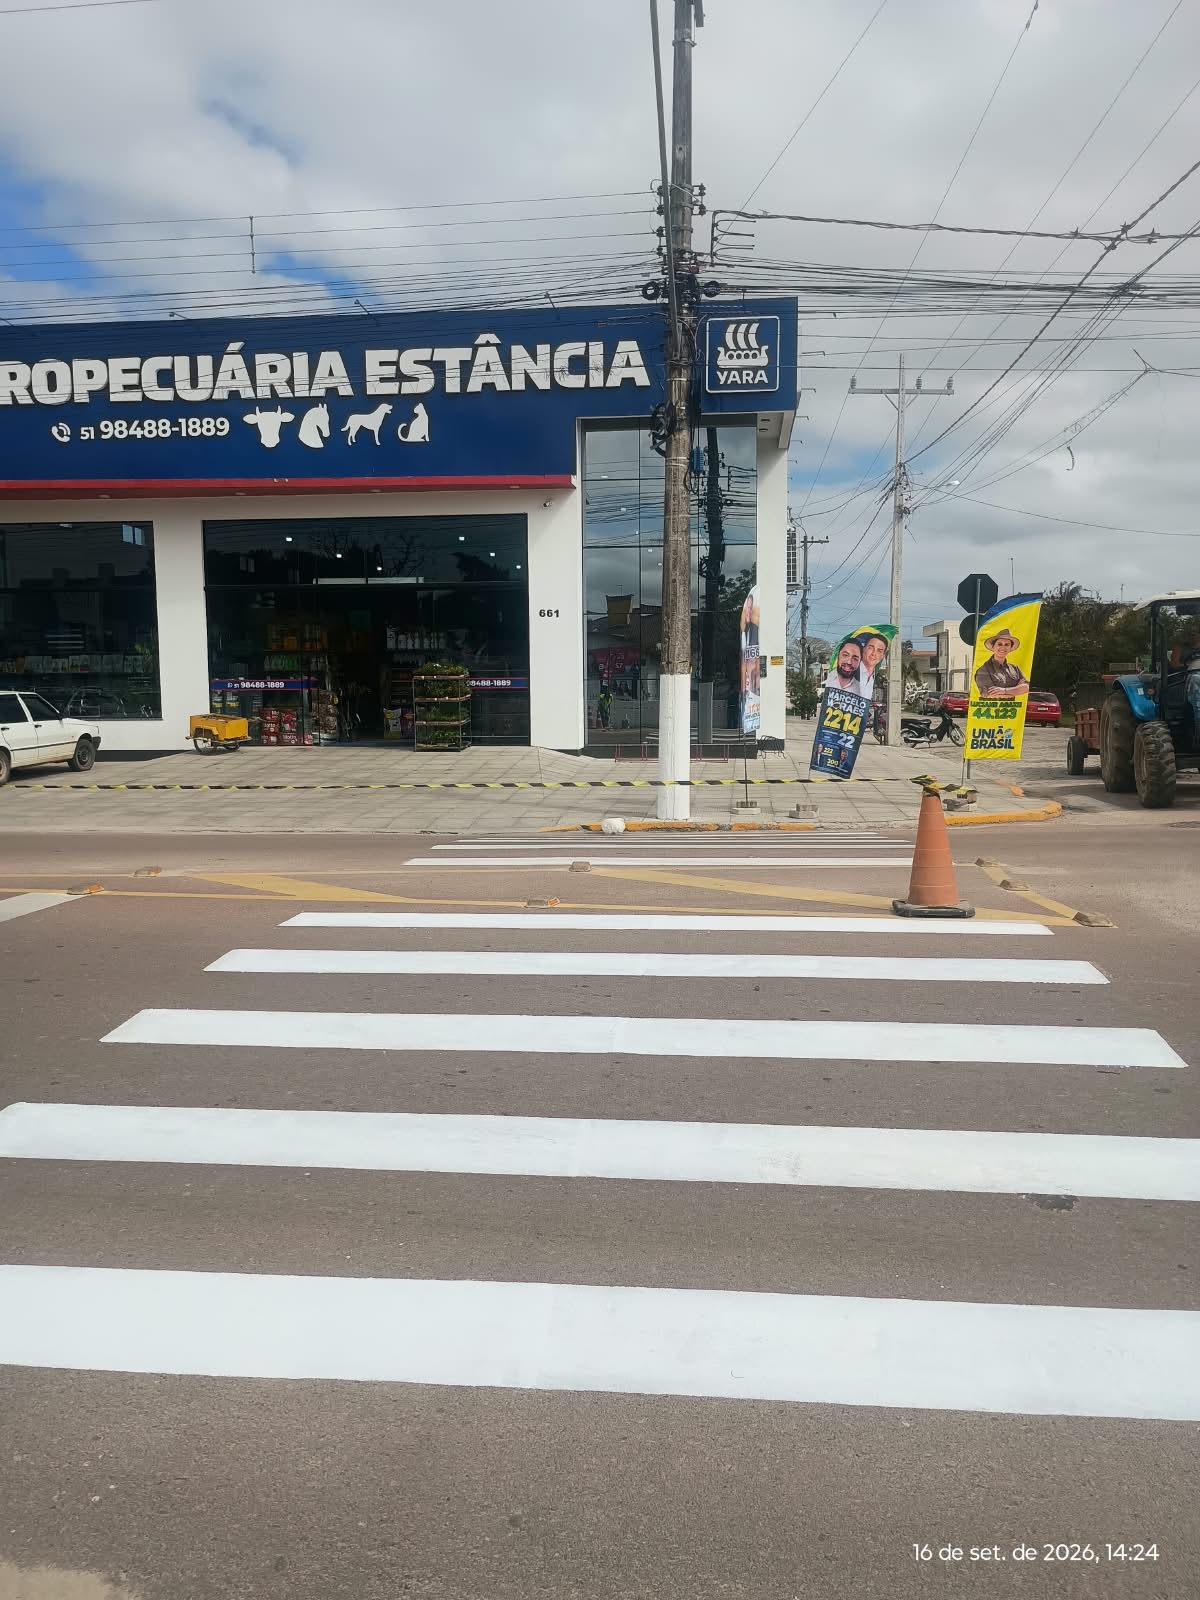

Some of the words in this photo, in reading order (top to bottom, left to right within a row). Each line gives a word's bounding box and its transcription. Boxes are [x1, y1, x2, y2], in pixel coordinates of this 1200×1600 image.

[364, 333, 651, 396] ESTÂNCIA
[716, 370, 769, 385] YARA
[80, 426, 95, 440] 51
[100, 417, 230, 440] 98488-1889
[539, 609, 560, 618] 661
[240, 681, 285, 689] 98488-1889
[827, 696, 865, 717] MORAES
[828, 691, 867, 709] MARCELO
[823, 706, 862, 736] 2214
[973, 707, 1018, 720] 44.123
[972, 725, 1014, 739] UNIÃO
[837, 732, 856, 749] 22
[970, 738, 1015, 750] BRASIL
